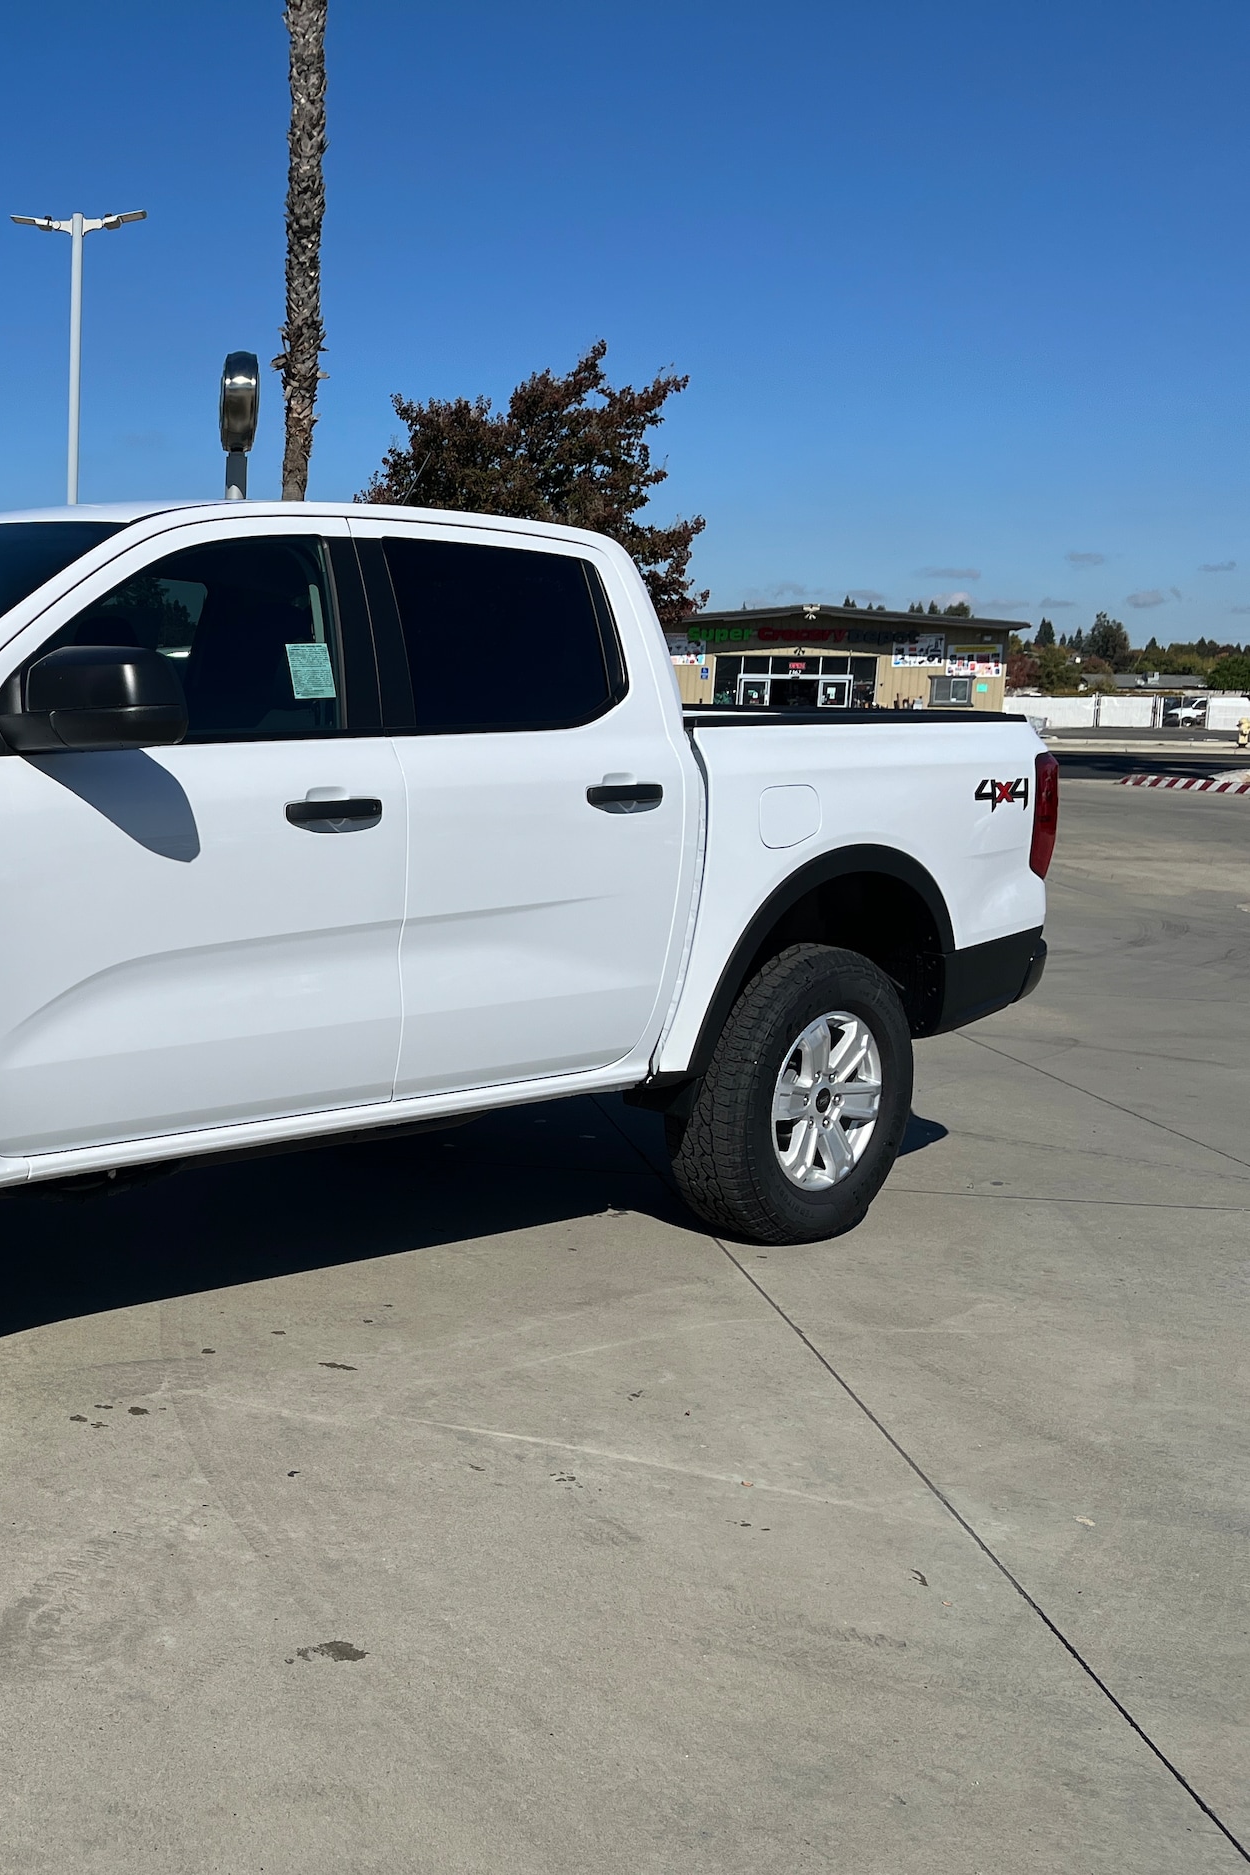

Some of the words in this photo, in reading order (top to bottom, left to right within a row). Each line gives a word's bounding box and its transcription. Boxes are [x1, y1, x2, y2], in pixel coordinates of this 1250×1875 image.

[687, 626, 753, 643] Super
[757, 626, 847, 643] Grocery
[974, 777, 1029, 813] 4x4
